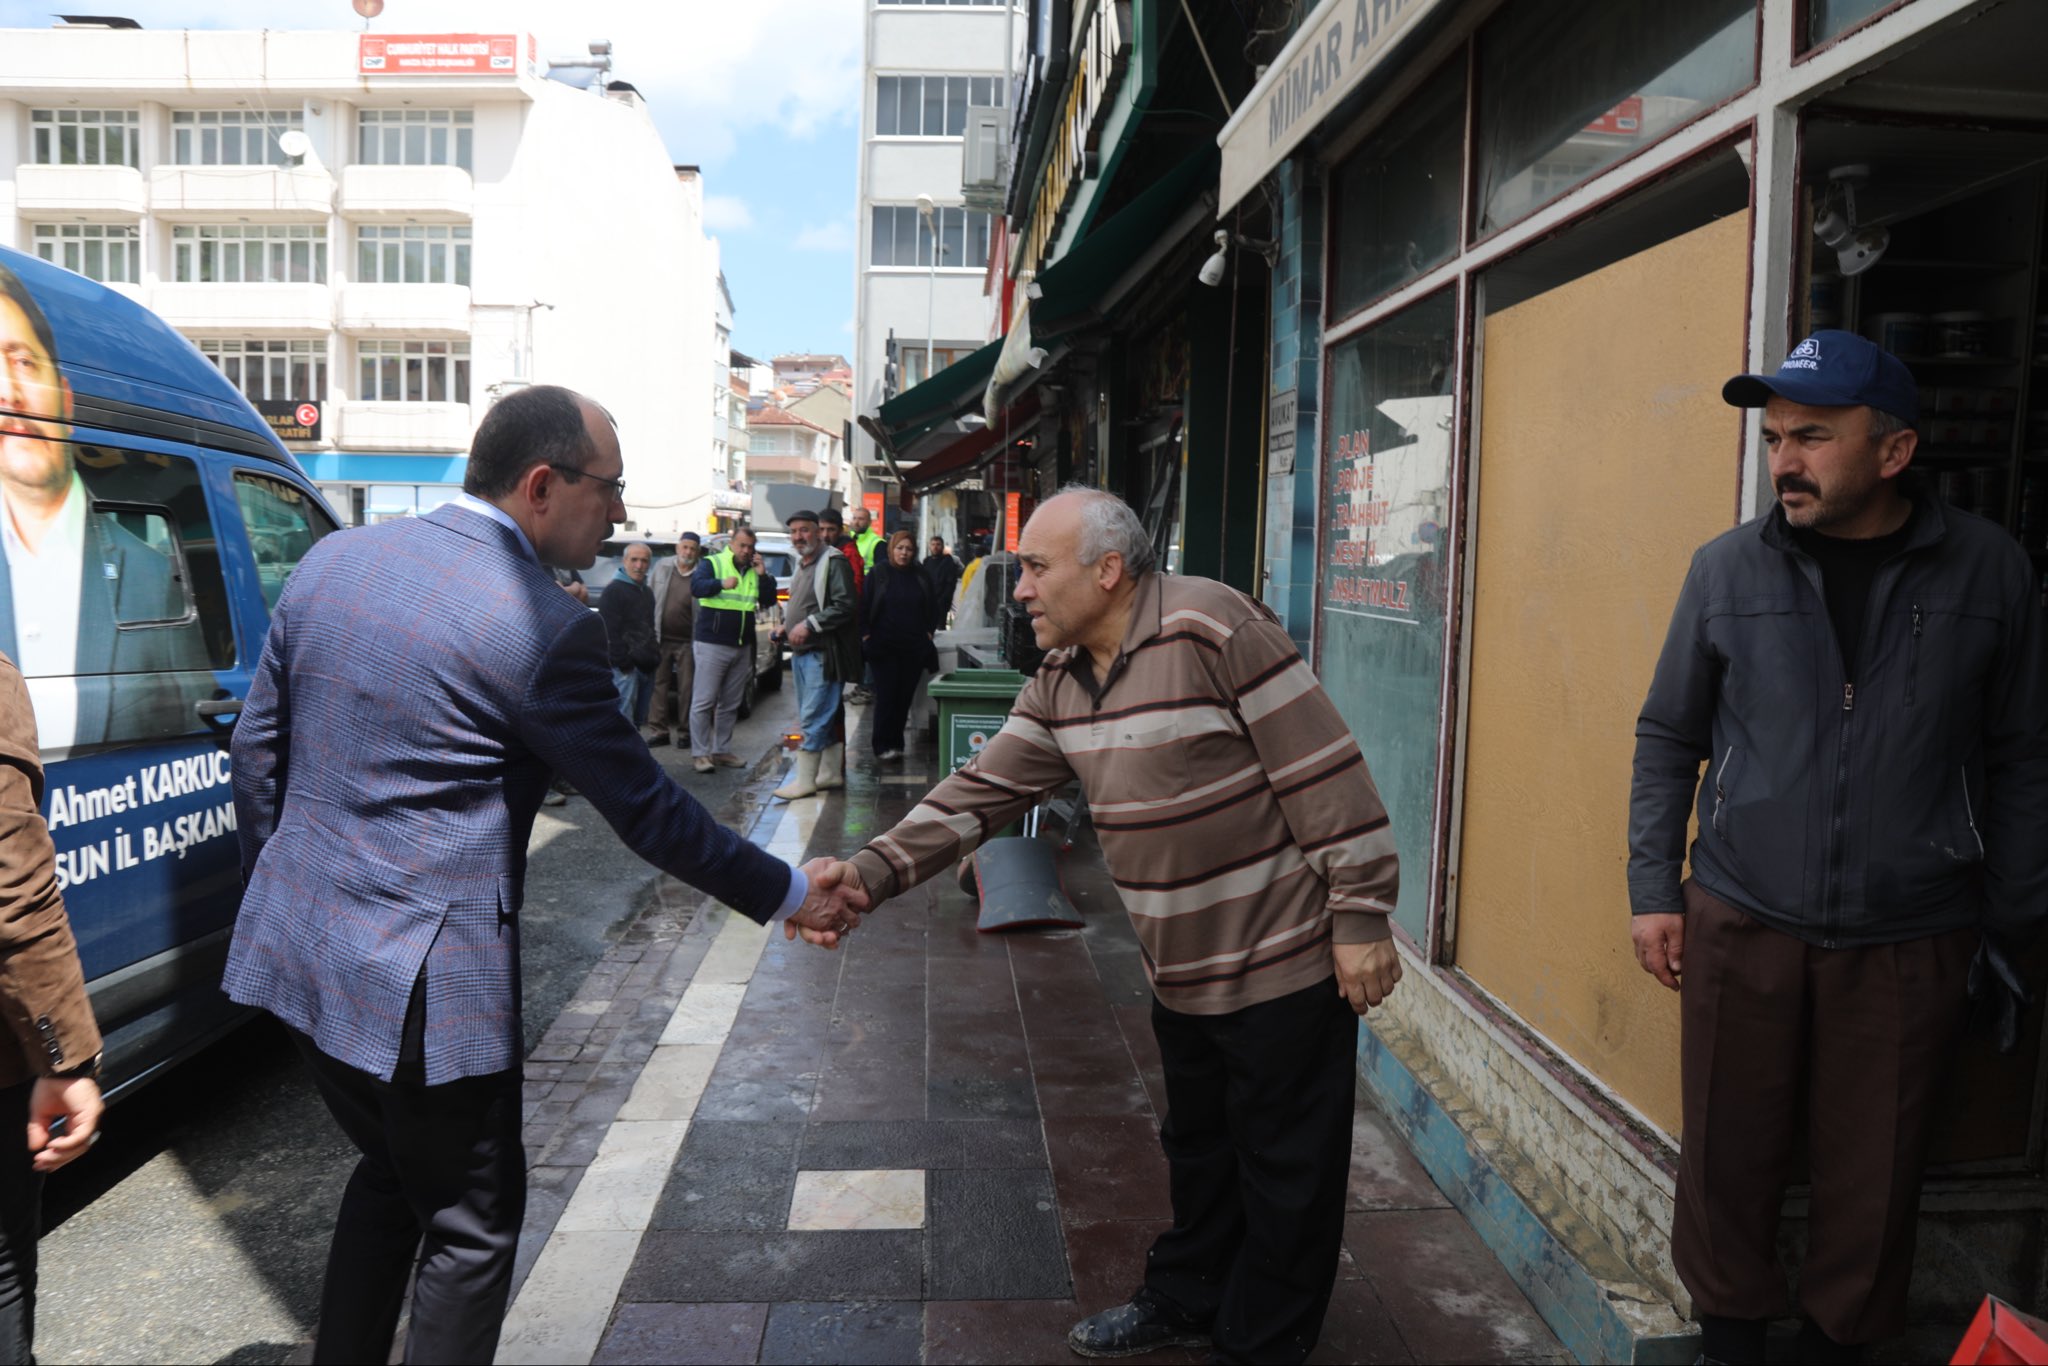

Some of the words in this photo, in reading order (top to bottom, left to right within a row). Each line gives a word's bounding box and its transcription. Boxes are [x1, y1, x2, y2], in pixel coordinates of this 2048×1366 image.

[437, 43, 459, 55] HALK
[459, 41, 490, 55] PARTİSİ
[1269, 20, 1342, 148] MİMAR
[1349, 0, 1409, 63] AH
[1781, 359, 1817, 370] PIONEER
[1270, 401, 1295, 427] AVUKAT
[48, 775, 138, 832] Ahmet
[55, 840, 110, 892] SUN
[115, 827, 139, 871] İL
[143, 801, 238, 860] BAŞKANI
